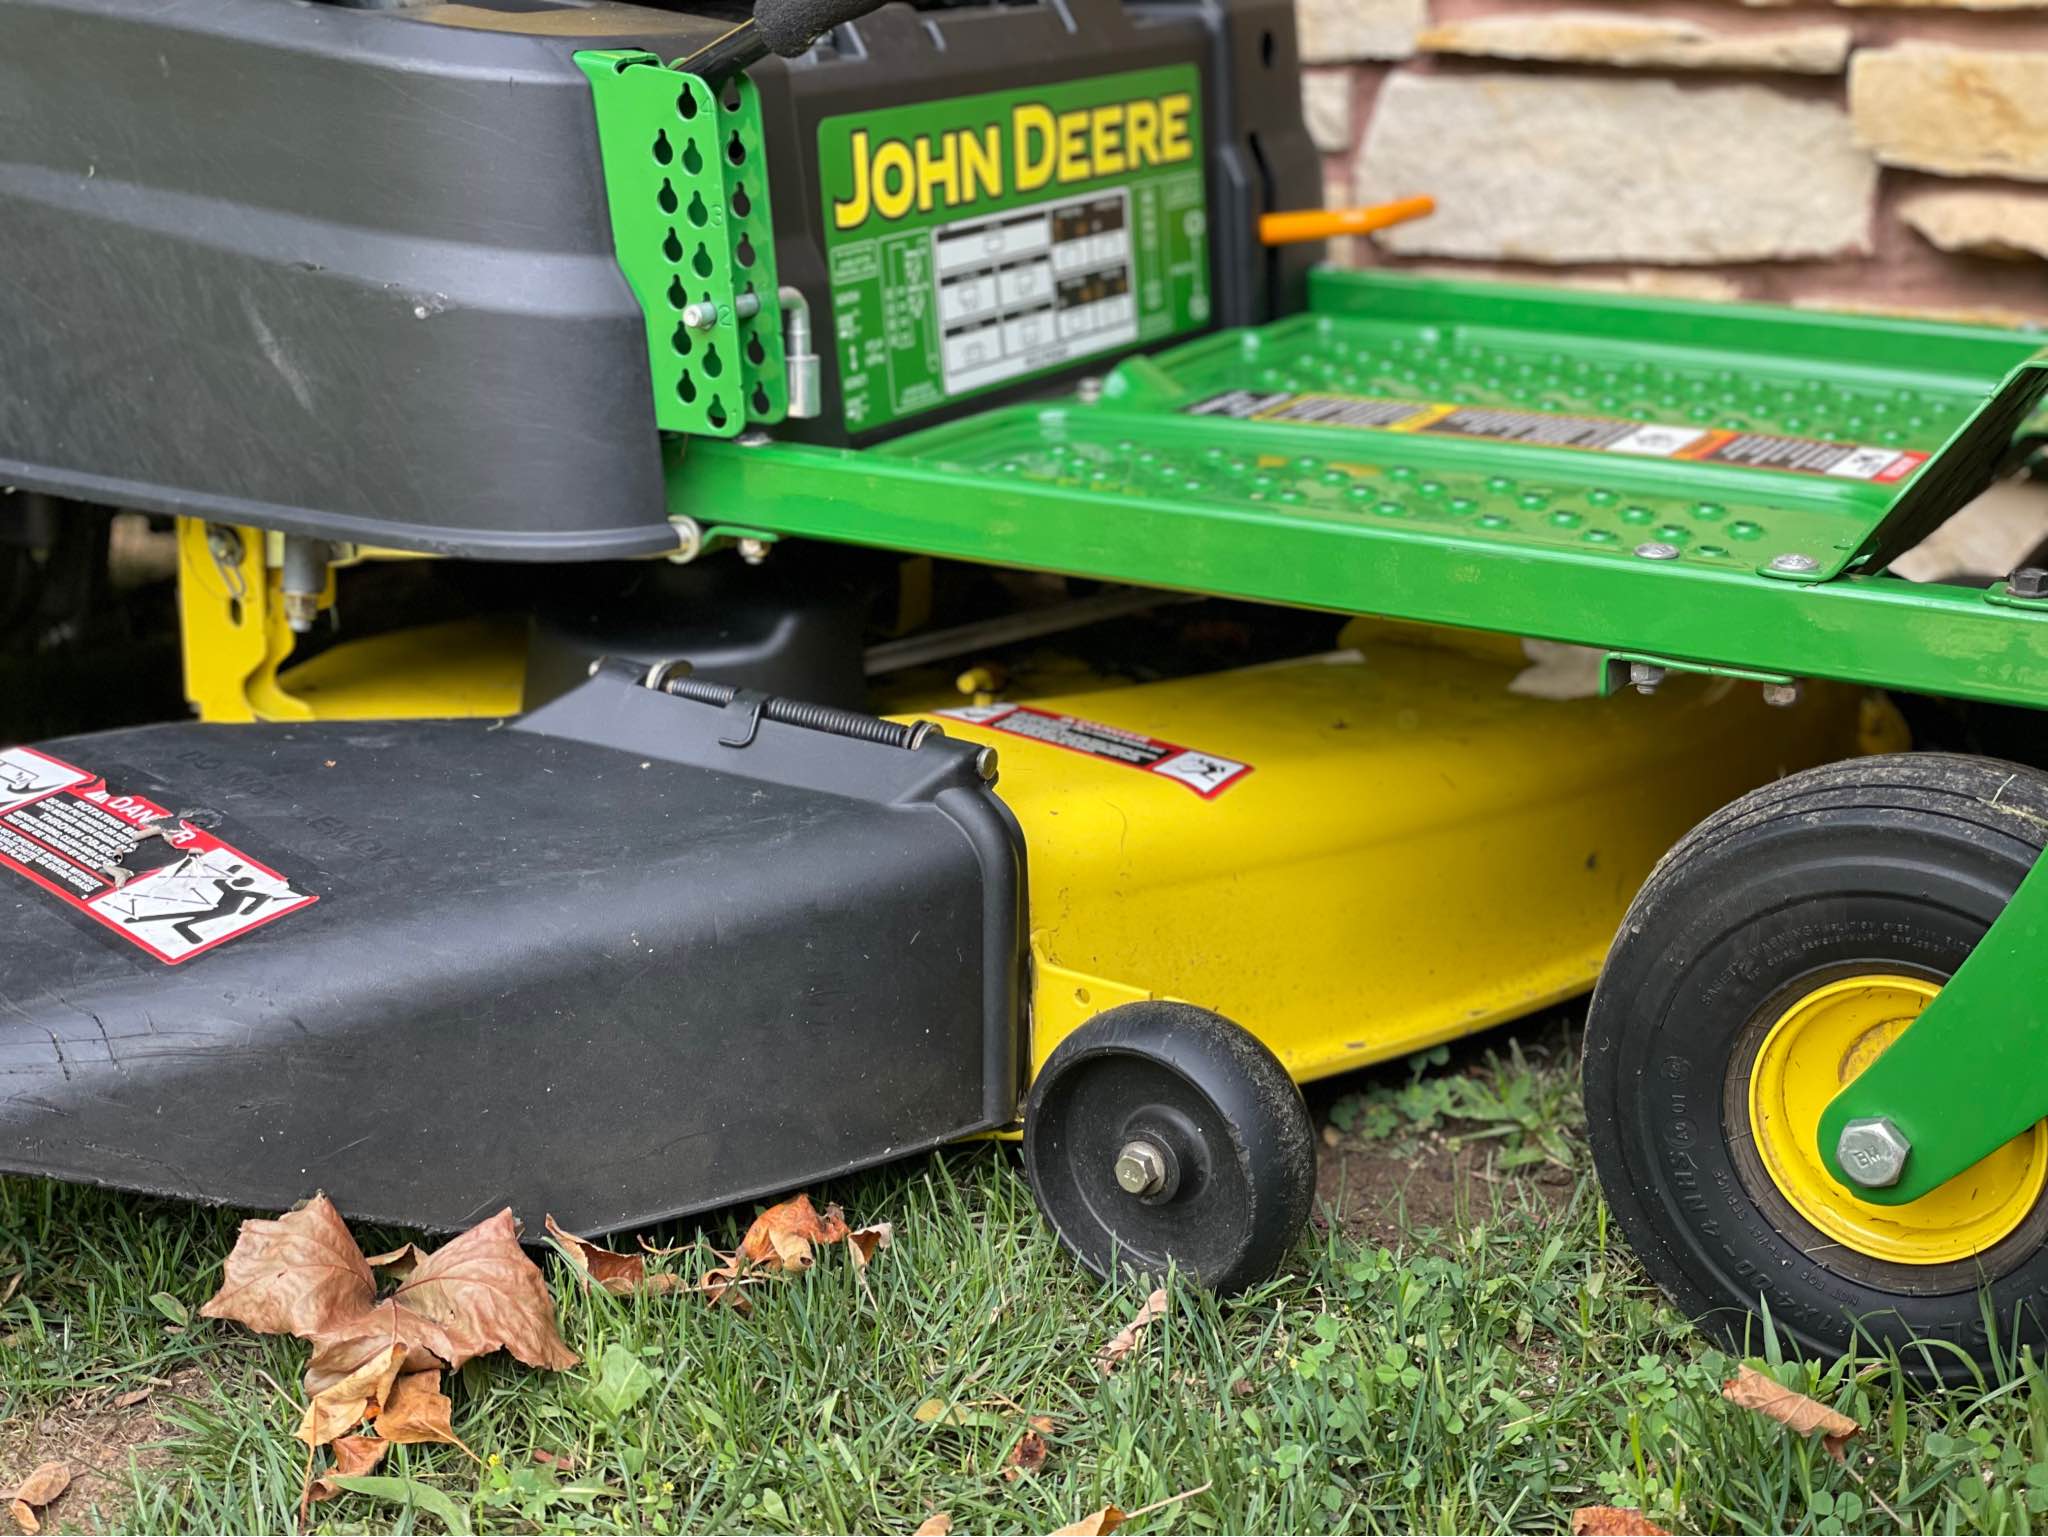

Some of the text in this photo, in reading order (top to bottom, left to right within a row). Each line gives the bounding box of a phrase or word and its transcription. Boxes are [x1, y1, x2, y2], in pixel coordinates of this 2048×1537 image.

[833, 92, 1194, 230] JOHN DEERE
[711, 204, 722, 226] 3
[718, 303, 734, 328] 2
[39, 813, 84, 838] THROWN
[46, 797, 58, 805] DO
[55, 803, 73, 811] NOT
[81, 816, 107, 829] HANDS
[103, 827, 116, 835] OR
[114, 832, 132, 845] FEET
[73, 801, 125, 829] ROTATING
[60, 835, 83, 848] CLEAR
[93, 831, 120, 847] ENGINE
[13, 836, 47, 855] OPERATE
[42, 852, 71, 869] MOWER
[68, 866, 103, 887] WITHOUT
[67, 876, 95, 892] GRASS
[1711, 1166, 1746, 1221] SERVICE
